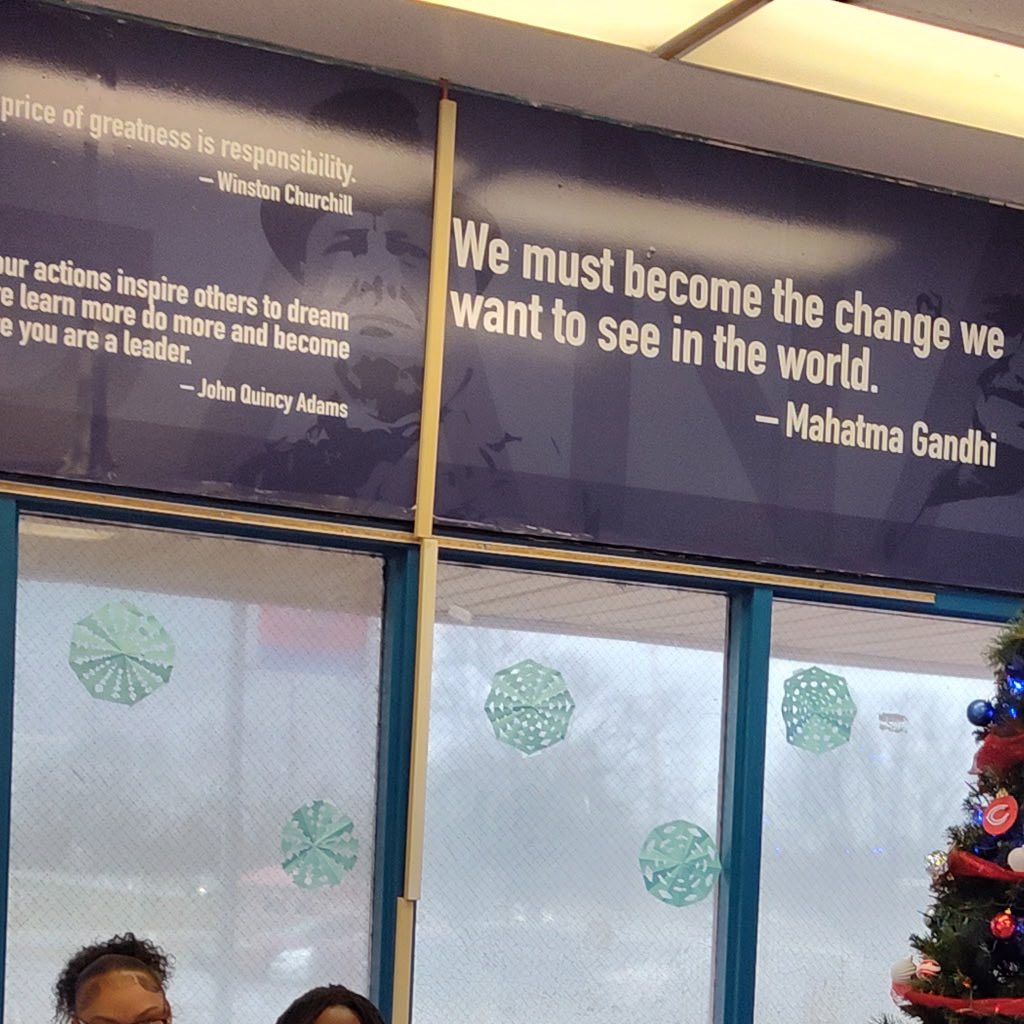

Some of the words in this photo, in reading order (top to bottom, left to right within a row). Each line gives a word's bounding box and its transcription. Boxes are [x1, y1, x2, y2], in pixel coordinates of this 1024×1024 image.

[1, 94, 57, 123] price
[63, 104, 85, 130] of
[89, 112, 191, 151] greatness
[197, 128, 215, 155] is
[221, 136, 357, 183] responsibility.
[217, 171, 281, 202] Winston
[284, 184, 353, 216] Churchill
[0, 255, 29, 278] ur
[33, 259, 112, 292] actions
[117, 269, 189, 307] inspire
[194, 286, 258, 315] others
[262, 295, 282, 320] to
[287, 298, 350, 331] dream
[0, 285, 14, 307] e
[20, 282, 75, 317] learn
[81, 300, 136, 327] more
[142, 303, 167, 331] do
[173, 315, 226, 341] more
[231, 318, 268, 348] and
[273, 331, 351, 361] become
[452, 217, 509, 275] We
[522, 242, 614, 294] must
[624, 249, 762, 318] become
[772, 278, 823, 329] the
[835, 291, 951, 359] change
[960, 320, 1005, 360] we
[0, 316, 13, 337] e
[18, 320, 58, 346] you
[63, 326, 99, 351] are
[104, 333, 118, 354] a
[124, 330, 192, 365] leader.
[450, 290, 542, 340] want
[552, 299, 586, 347] to
[598, 316, 660, 358] see
[671, 315, 703, 366] in
[713, 325, 767, 376] the
[777, 343, 879, 393] world.
[197, 378, 236, 402] John
[240, 385, 293, 415] Quincy
[296, 393, 348, 418] Adams
[786, 401, 904, 453] Mahatma
[911, 423, 997, 468] Gandhi
